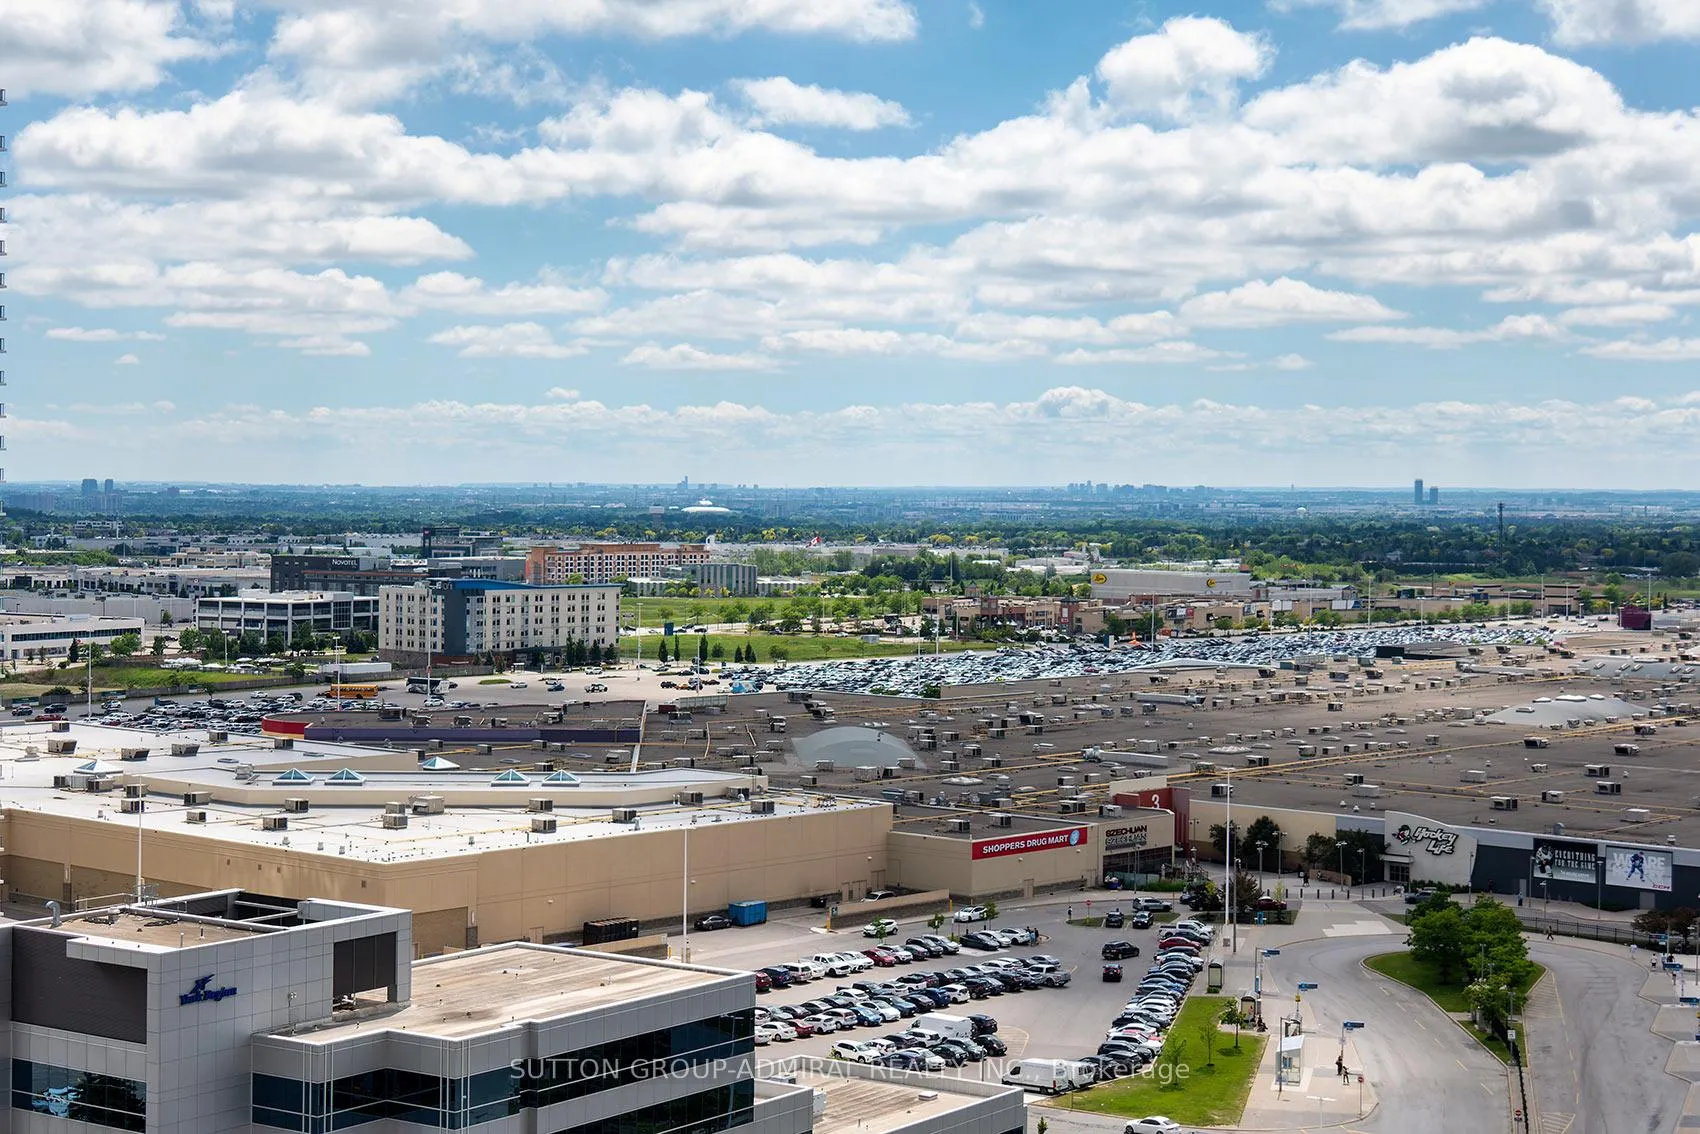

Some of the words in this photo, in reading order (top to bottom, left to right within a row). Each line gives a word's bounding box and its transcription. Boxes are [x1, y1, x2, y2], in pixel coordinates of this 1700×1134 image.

[1152, 794, 1160, 809] 3
[1105, 825, 1148, 838] SZECHUAN
[1413, 826, 1459, 847] Hockey
[982, 842, 1026, 854] SHOPPERS
[1026, 839, 1047, 848] DRUG
[1047, 834, 1069, 844] MART
[1426, 839, 1454, 855] Life
